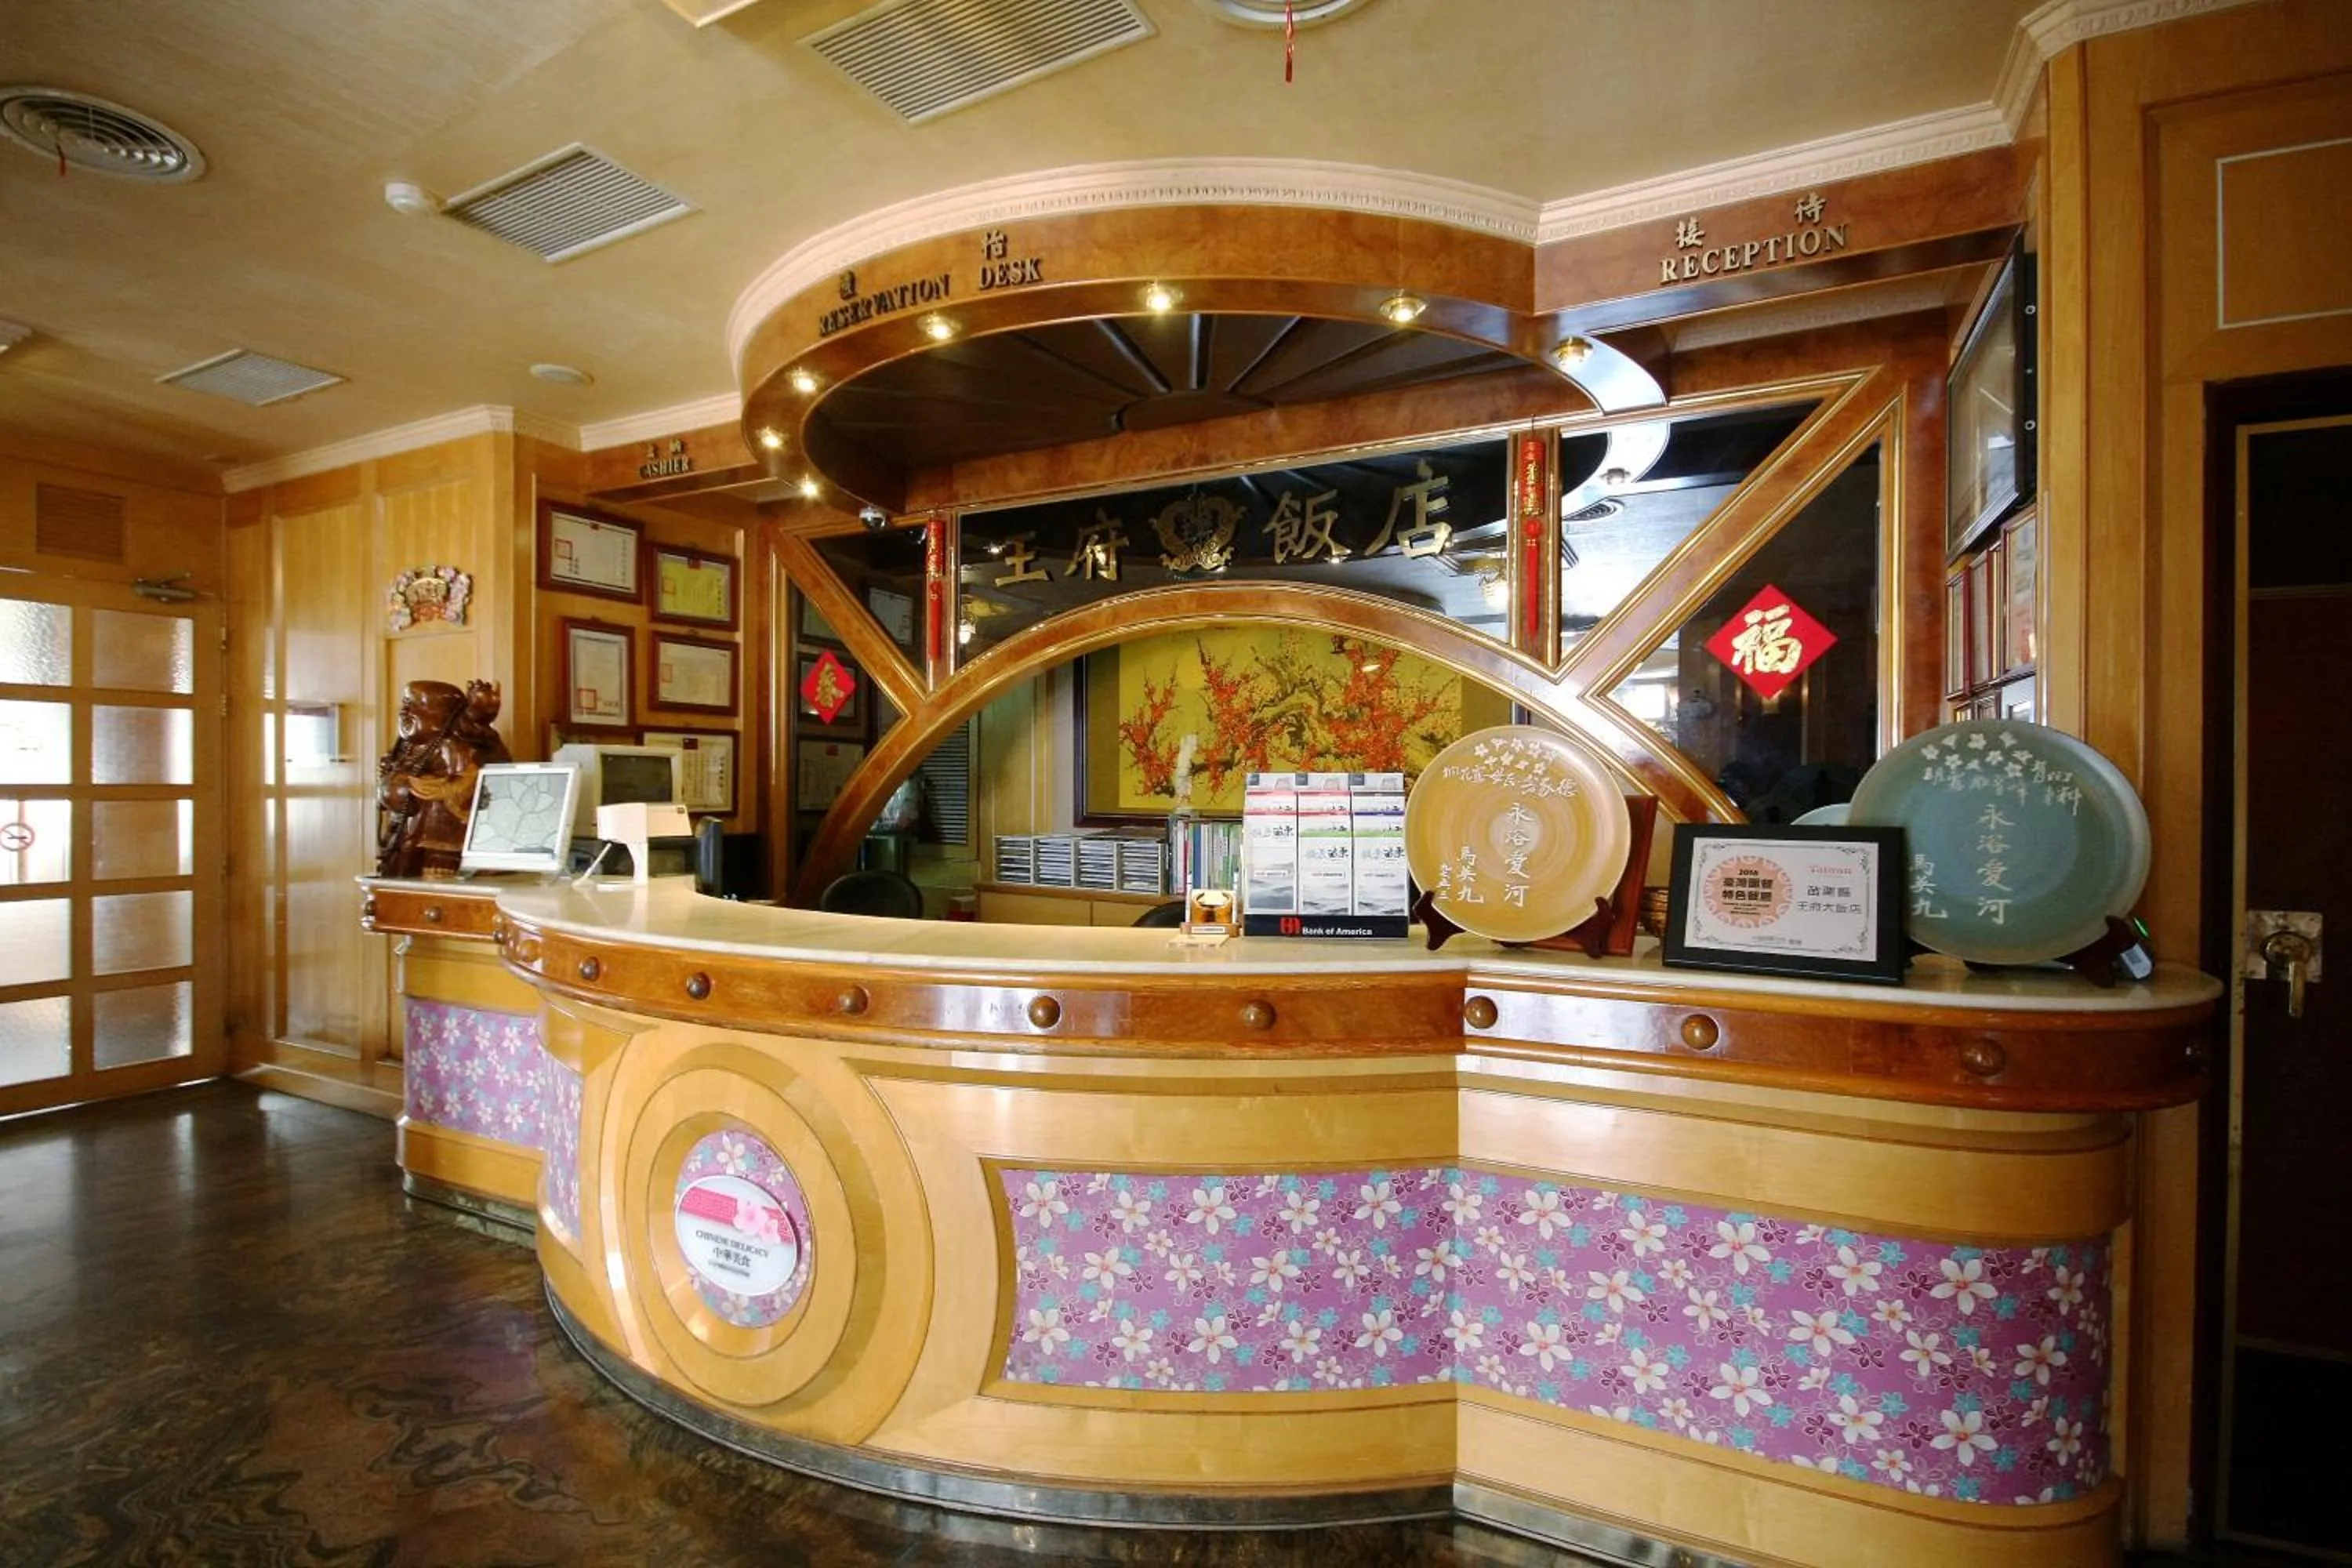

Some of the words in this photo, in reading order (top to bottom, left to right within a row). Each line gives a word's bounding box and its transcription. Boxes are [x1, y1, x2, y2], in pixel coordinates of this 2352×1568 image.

[1660, 224, 1846, 284] RECEPTION
[1675, 216, 1706, 249] 接
[1794, 192, 1826, 223] 待
[818, 274, 950, 337] RESERVATION
[978, 258, 1043, 290] DESK
[993, 508, 1129, 587] 王府
[1262, 459, 1454, 564] 飯店
[1731, 604, 1802, 674] 福
[1457, 846, 1483, 903] 馬英九
[1504, 802, 1535, 907] 永浴愛河
[1911, 854, 1948, 919] 馬英九
[1976, 804, 2015, 924] 永浴愛河
[1337, 927, 1372, 936] America
